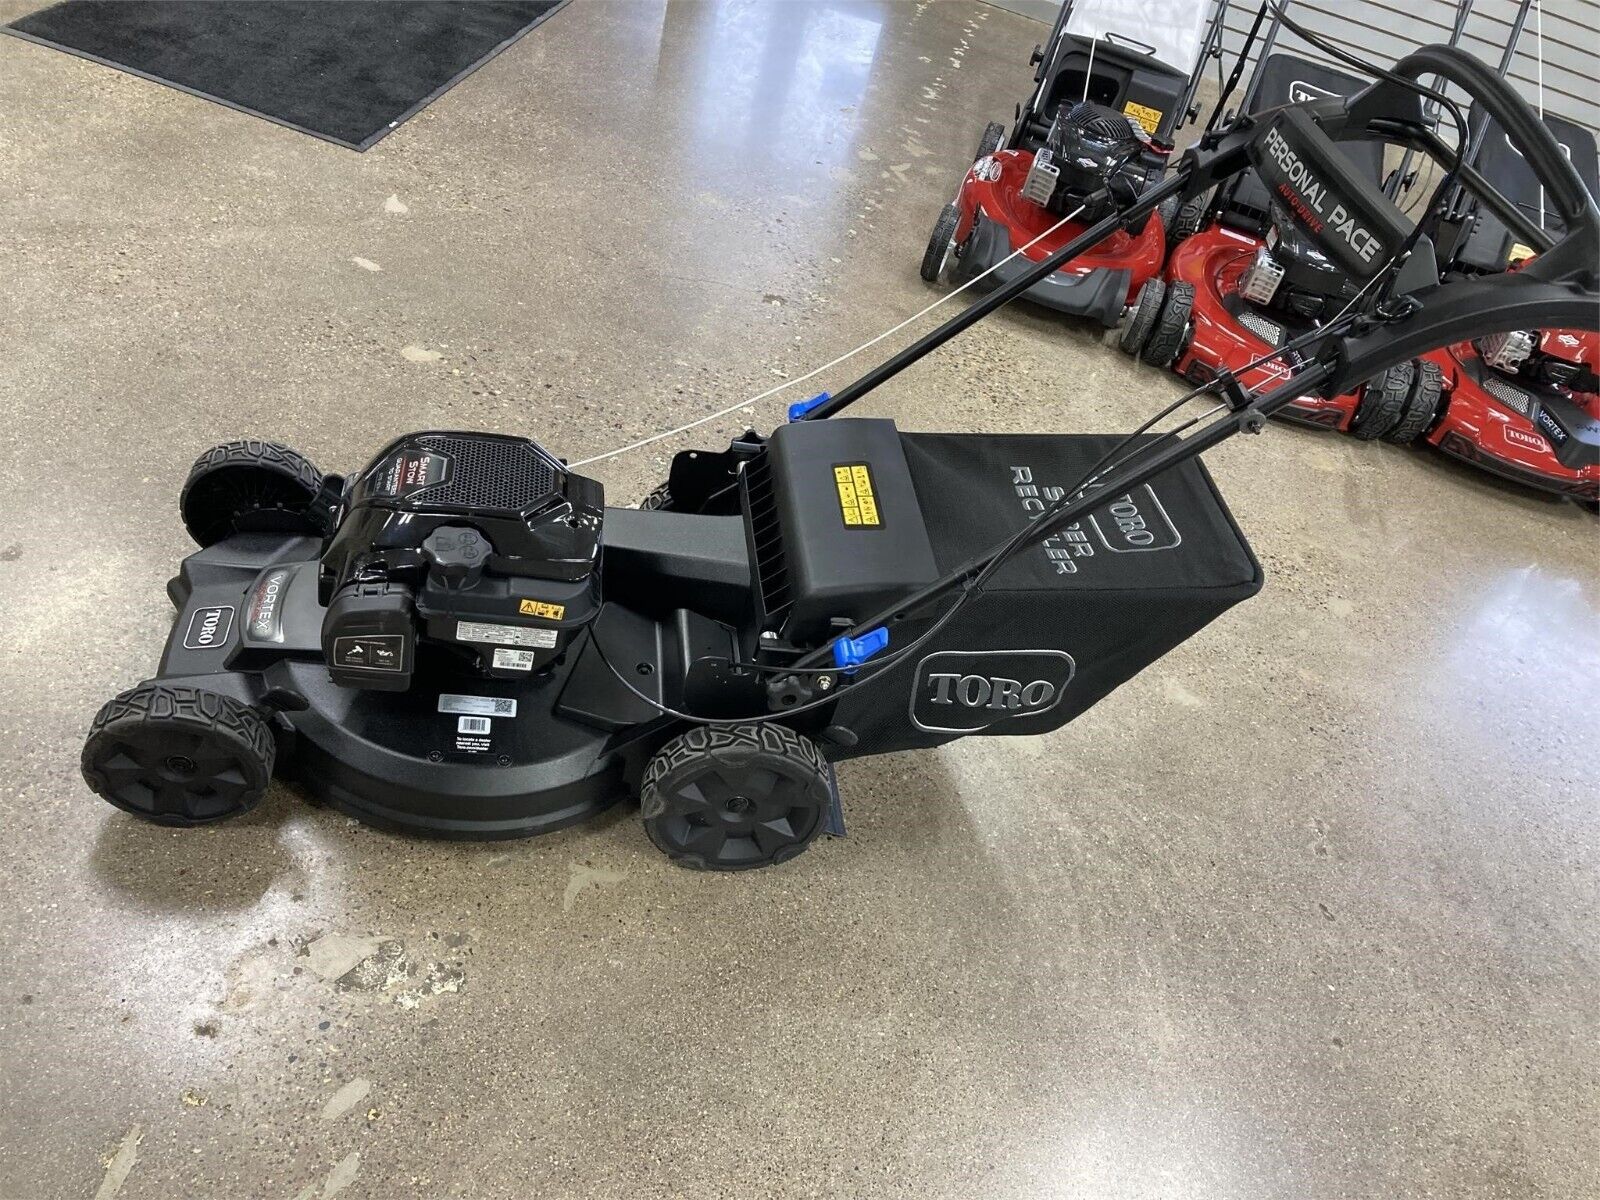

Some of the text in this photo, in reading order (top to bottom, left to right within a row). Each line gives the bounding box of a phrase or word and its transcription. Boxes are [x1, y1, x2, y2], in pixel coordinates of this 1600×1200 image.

[1263, 126, 1381, 264] PERSONAL PACE
[1507, 429, 1542, 446] TORO
[1538, 409, 1567, 441] VORTEX
[406, 460, 419, 485] STOW
[416, 456, 430, 486] SMART
[256, 576, 282, 630] VORTEX
[198, 609, 222, 645] TORO
[927, 673, 1055, 710] TORO
